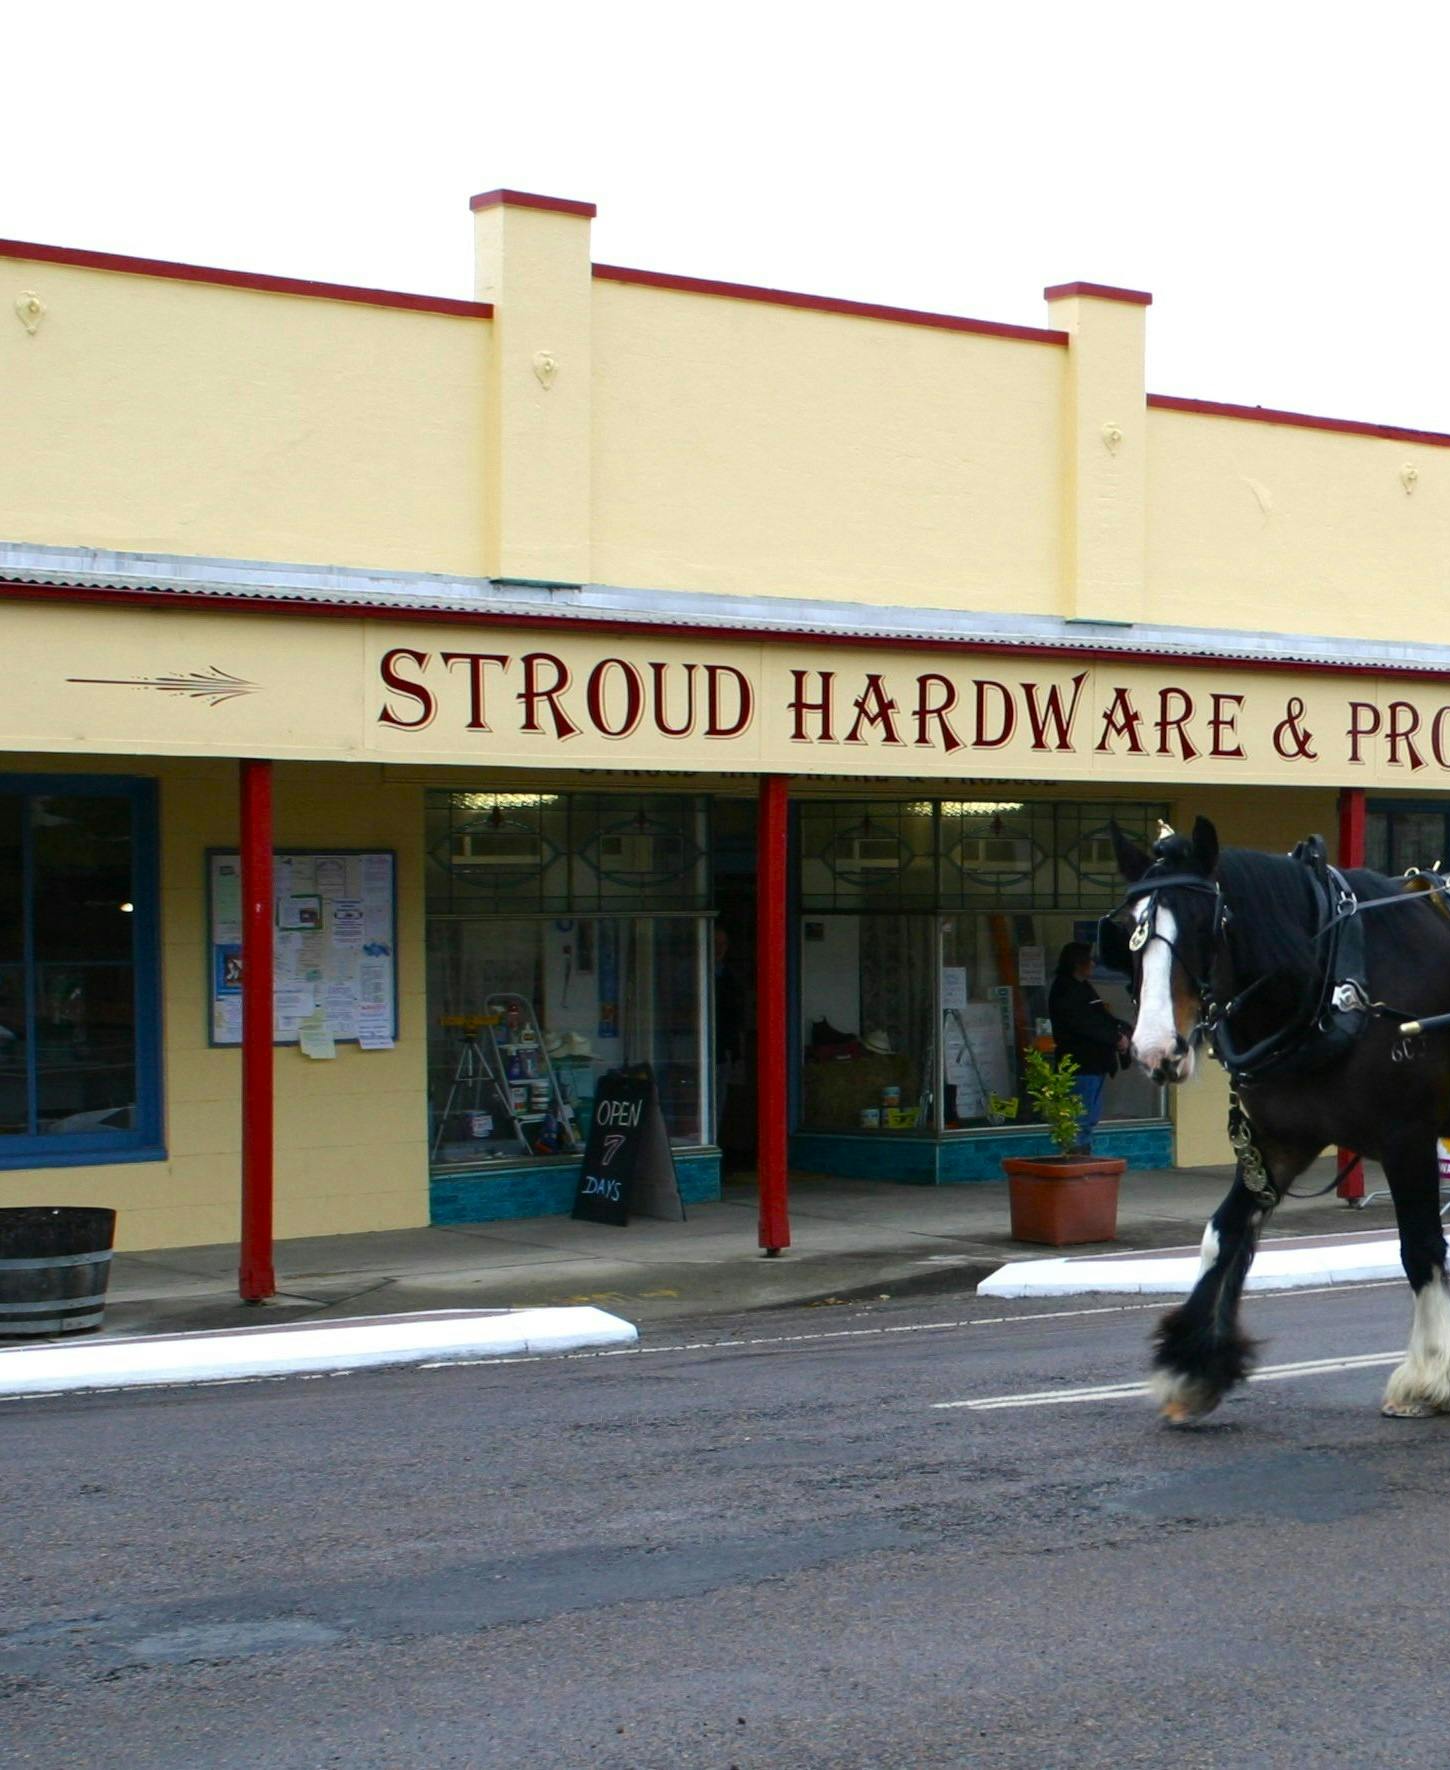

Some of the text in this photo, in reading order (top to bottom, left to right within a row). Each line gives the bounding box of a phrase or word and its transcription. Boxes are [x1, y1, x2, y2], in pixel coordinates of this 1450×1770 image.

[378, 647, 755, 742] STROUD
[786, 669, 1249, 765] HARDWARE
[1273, 696, 1319, 762] &
[597, 1099, 643, 1127] OPEN
[602, 1134, 626, 1166] 7
[581, 1175, 622, 1203] DAYS
